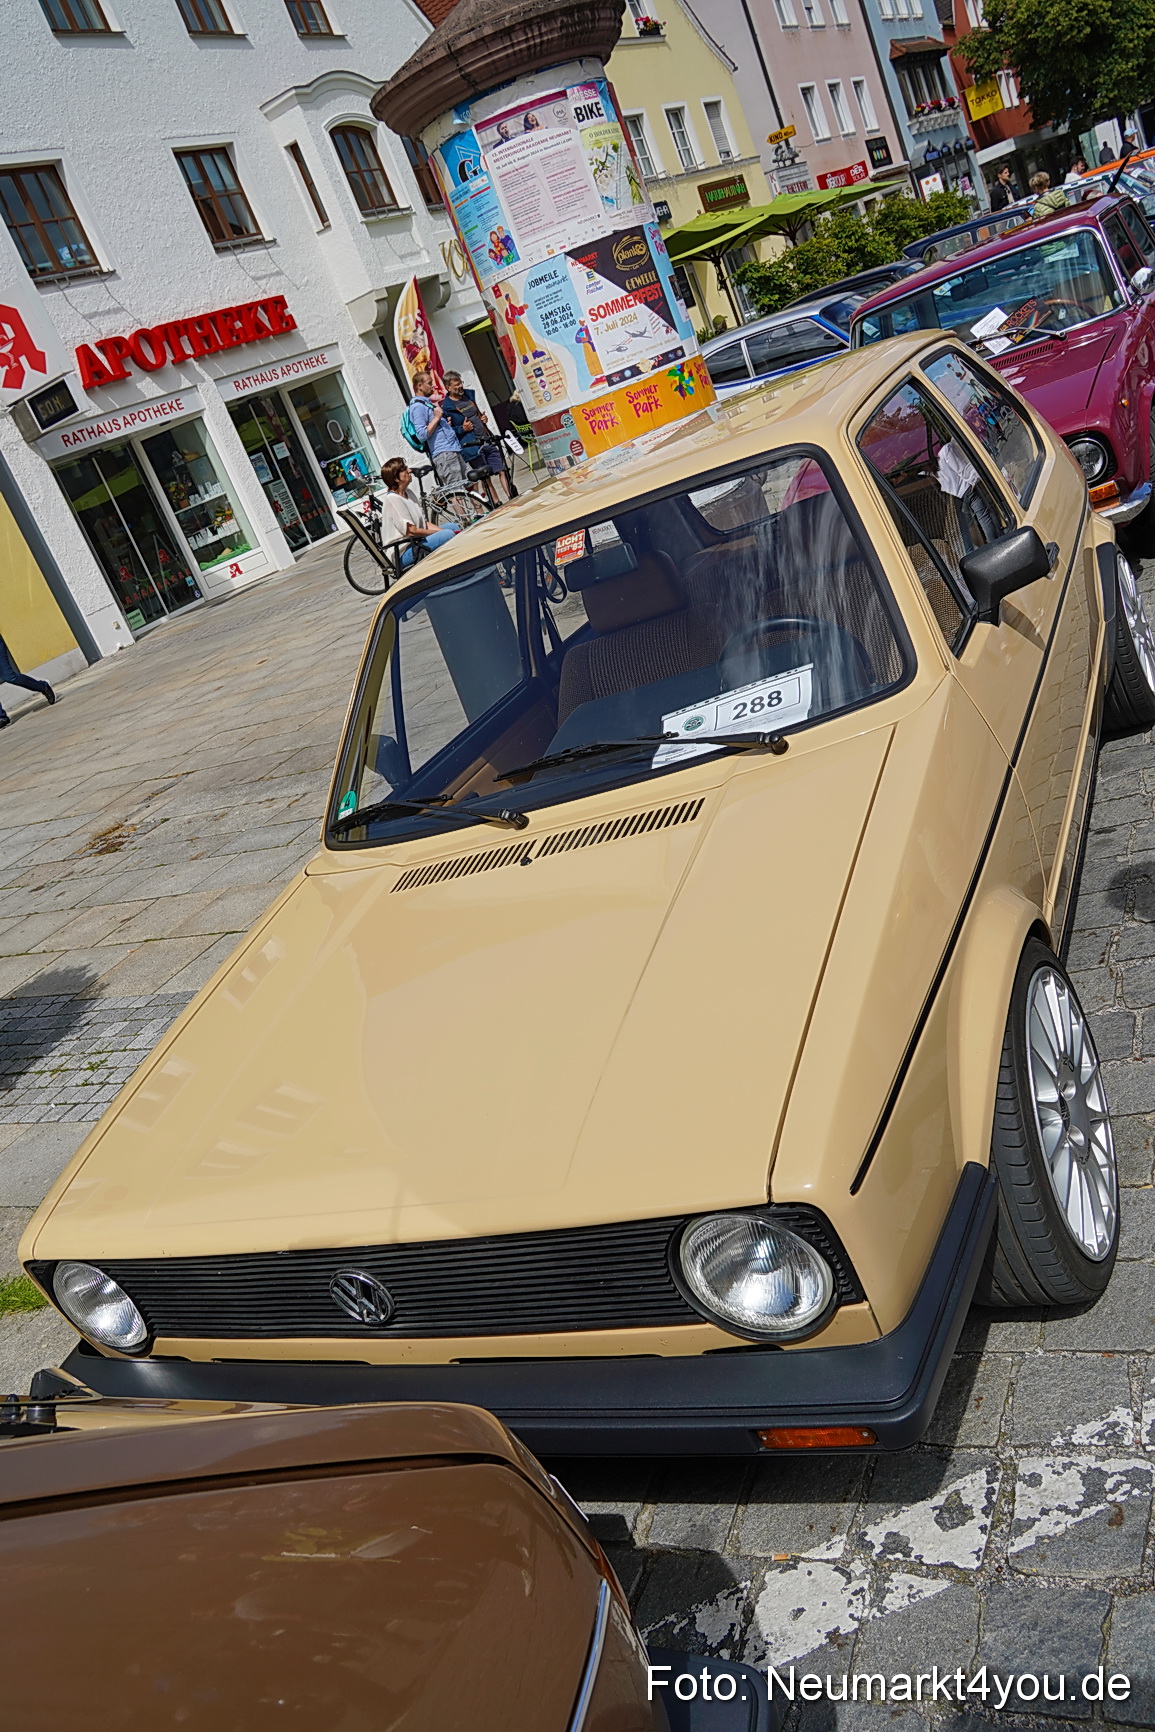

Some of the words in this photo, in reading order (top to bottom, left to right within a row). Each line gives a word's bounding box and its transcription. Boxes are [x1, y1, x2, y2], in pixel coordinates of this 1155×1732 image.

[969, 89, 998, 106] TAKKO
[525, 138, 549, 149] AKADEMIE
[548, 129, 572, 142] NEUMARKT
[768, 132, 783, 143] KINO
[528, 270, 559, 290] JOBMEILE
[586, 284, 604, 296] Fischer
[540, 302, 572, 322] SAMSTAG
[588, 282, 663, 323] SOMMERFEST
[400, 308, 425, 337] EIS
[543, 312, 574, 330] 29.06.2024
[594, 327, 603, 336] 7.
[604, 320, 619, 333] Juli
[620, 312, 638, 326] 2024
[1006, 299, 1038, 328] ROCKETS
[545, 325, 560, 337] 10:00
[563, 318, 577, 331] 16:00
[75, 295, 298, 390] APOTHEKE
[233, 368, 280, 392] RATHAUS
[281, 353, 328, 378] APOTHEKE
[625, 383, 659, 404] Sommer
[581, 401, 615, 421] Sommer
[633, 396, 663, 419] Park
[61, 418, 122, 447] RATHAUS
[122, 398, 185, 429] APOTHEKE
[589, 413, 619, 436] Park
[557, 533, 585, 548] LICHT
[732, 690, 783, 721] 288
